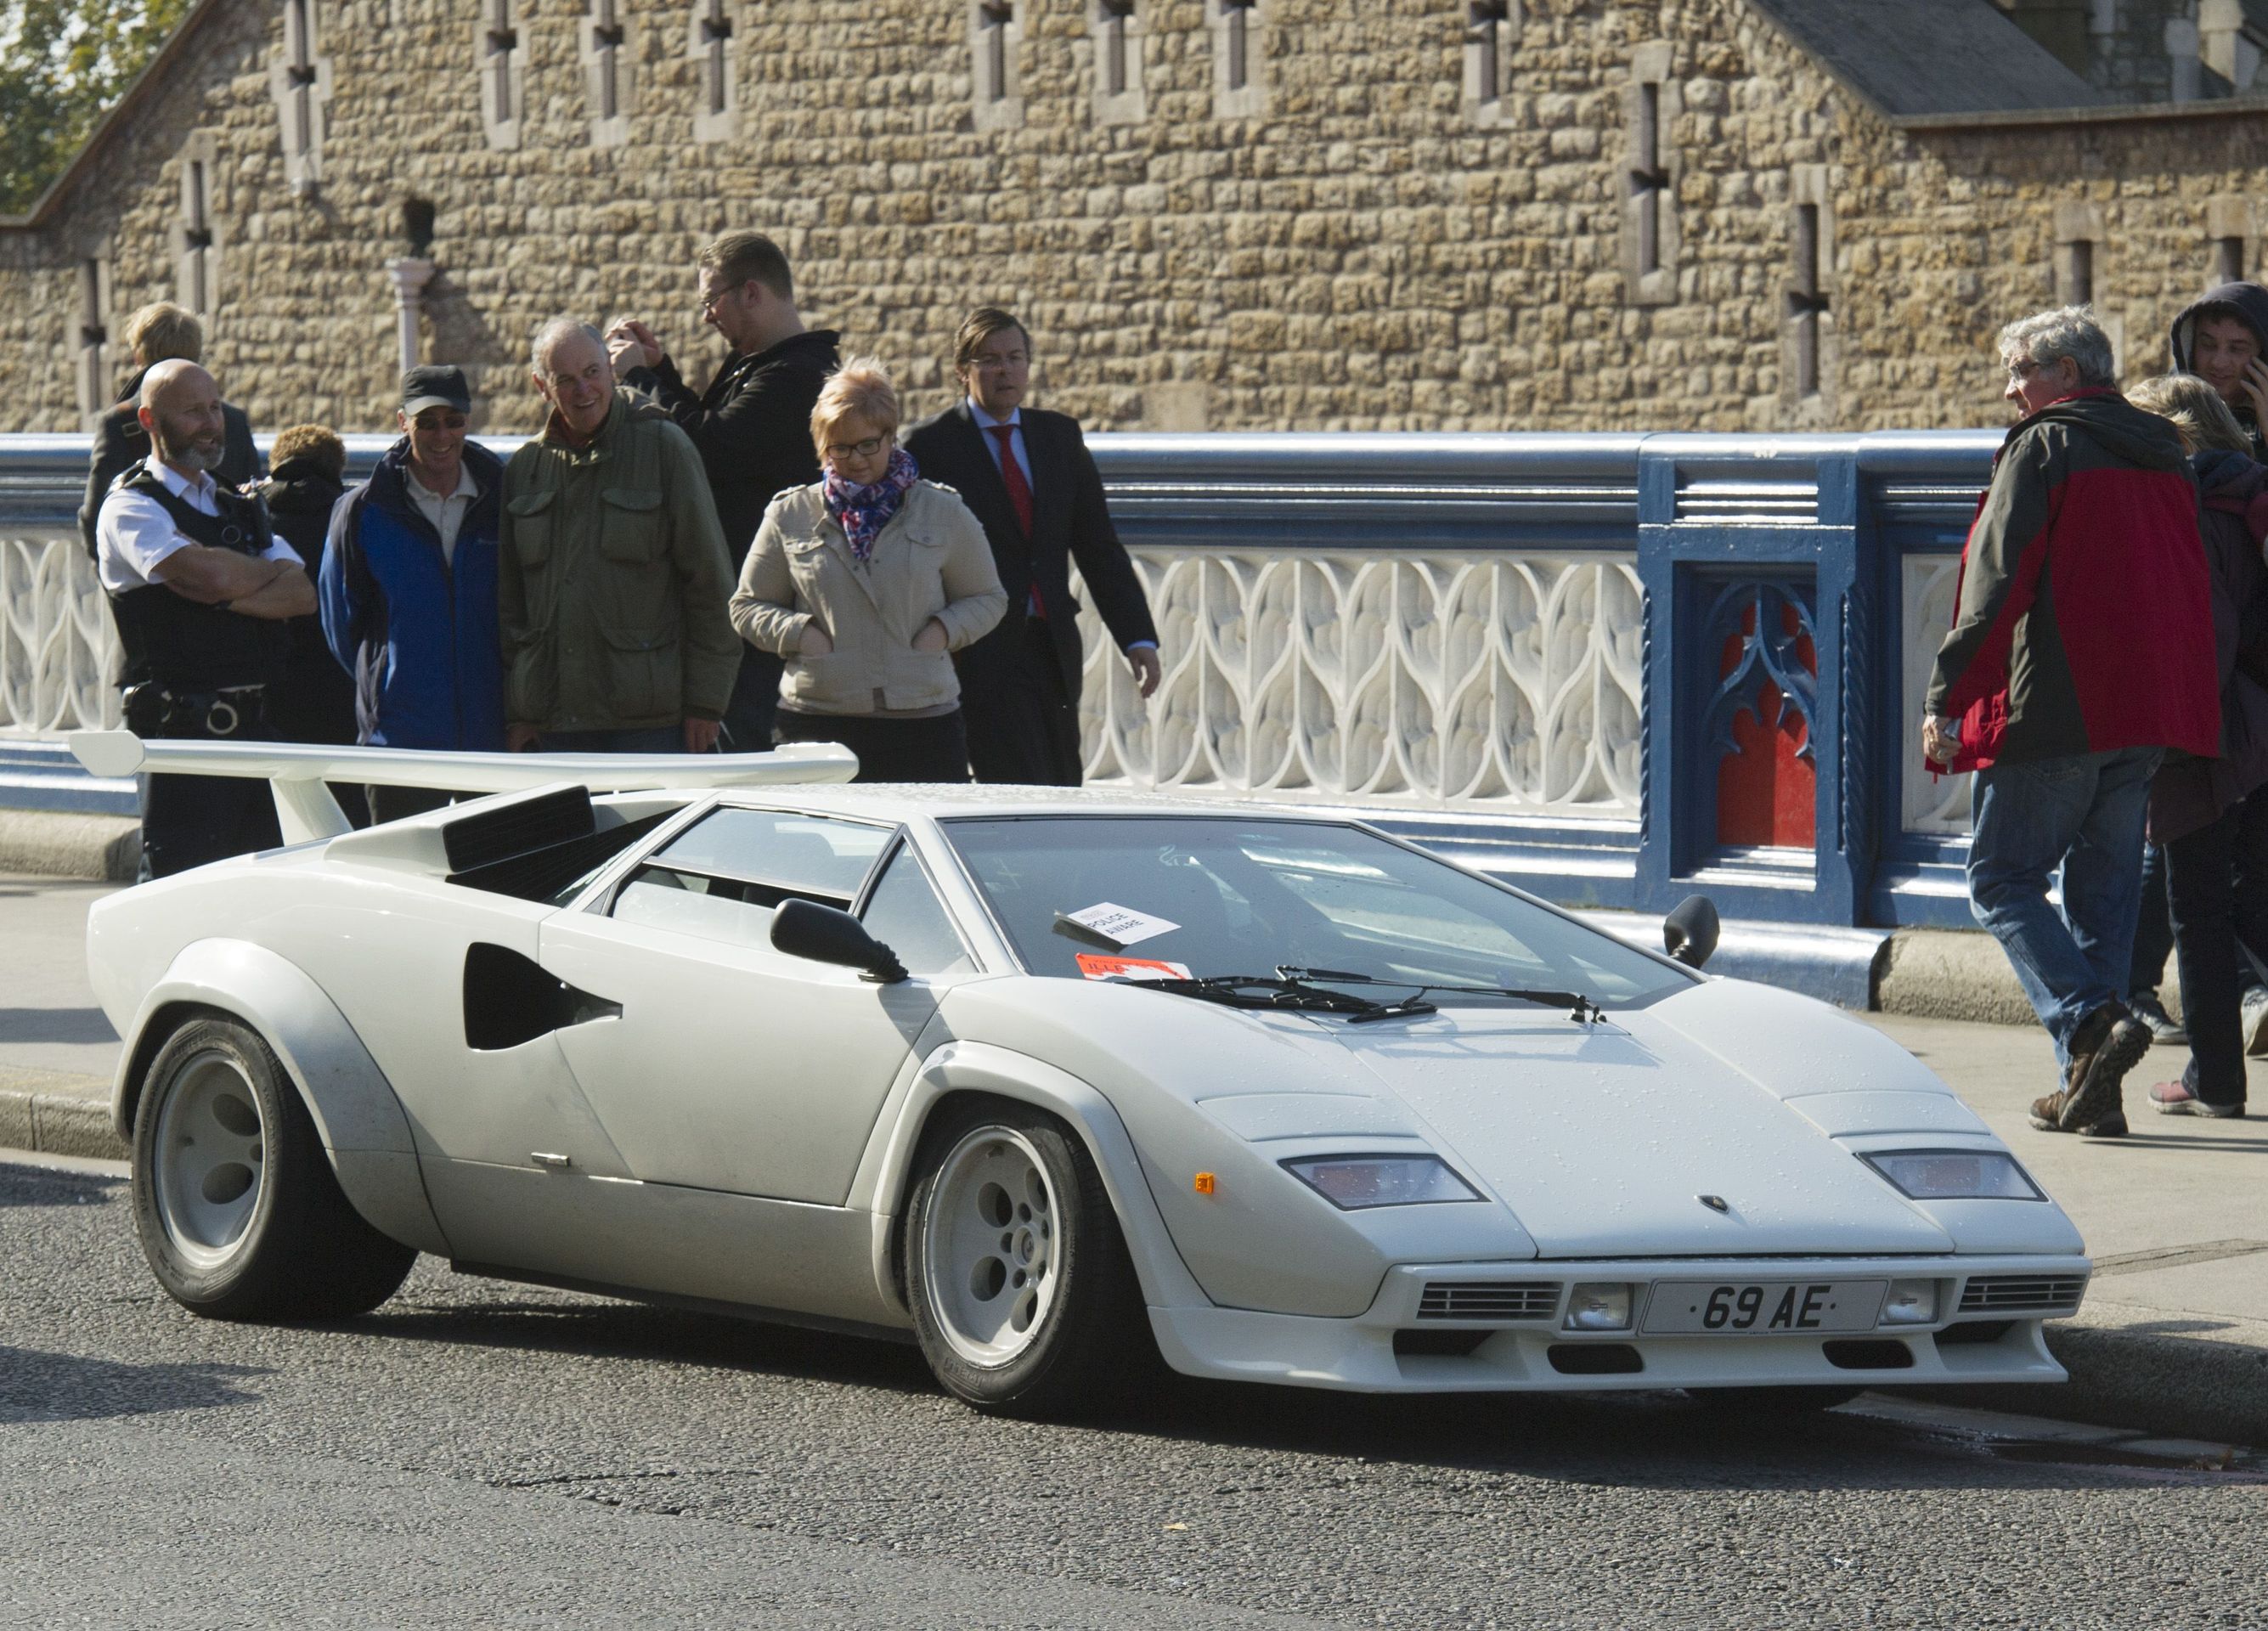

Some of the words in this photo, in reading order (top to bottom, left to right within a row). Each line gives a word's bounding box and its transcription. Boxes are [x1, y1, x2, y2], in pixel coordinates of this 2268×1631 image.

[1087, 913, 1128, 928] POLICE
[1105, 920, 1143, 934] AWARE
[1703, 1286, 1764, 1329] 69
[1769, 1285, 1831, 1328] AE
